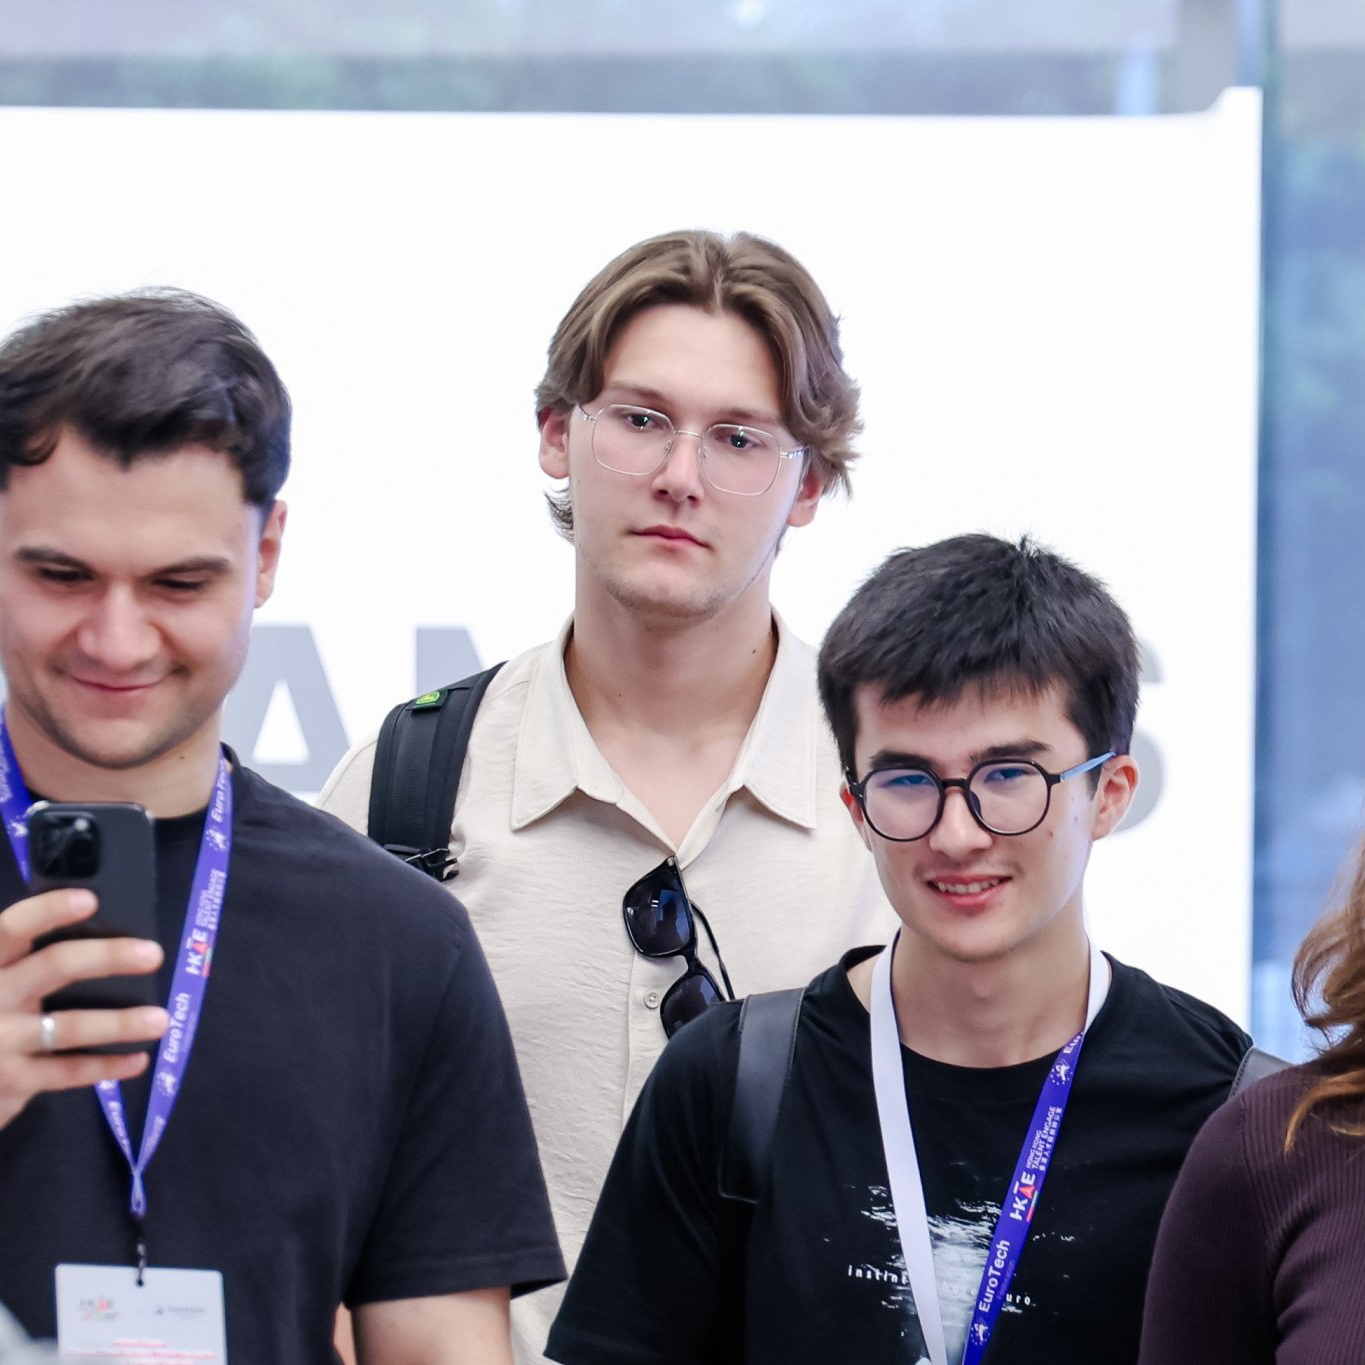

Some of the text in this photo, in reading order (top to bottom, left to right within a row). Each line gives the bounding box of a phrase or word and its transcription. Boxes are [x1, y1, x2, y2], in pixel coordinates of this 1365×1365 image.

[161, 991, 191, 1064] EuroTech
[1031, 1105, 1057, 1170] TALENT ENGAGE
[977, 1239, 1011, 1313] EuroTech
